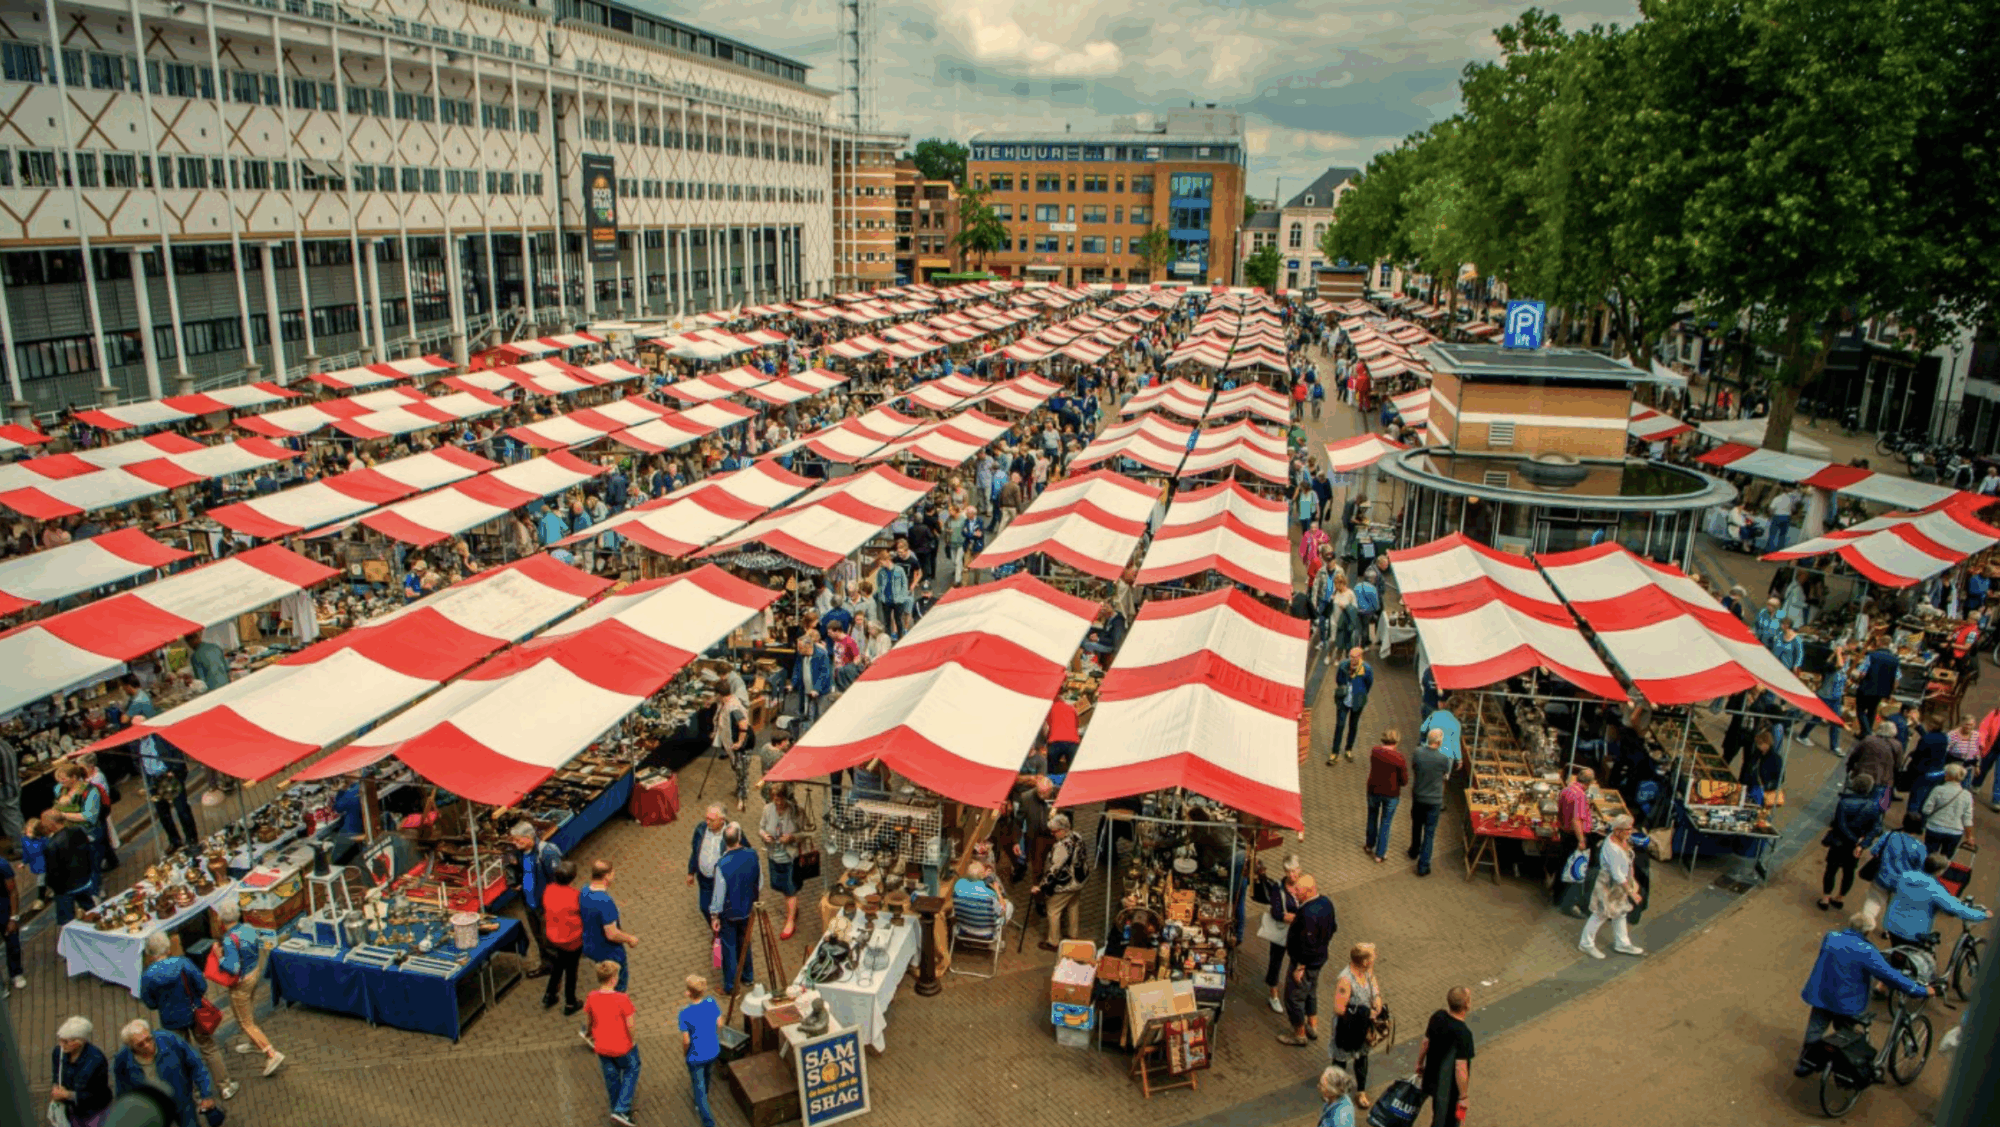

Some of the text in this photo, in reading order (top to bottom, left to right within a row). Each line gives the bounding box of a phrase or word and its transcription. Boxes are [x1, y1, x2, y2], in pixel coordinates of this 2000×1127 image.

[1516, 313, 1534, 334] P
[805, 1040, 856, 1070] SAM
[806, 1056, 856, 1088] SON
[810, 1087, 859, 1115] SHAG
